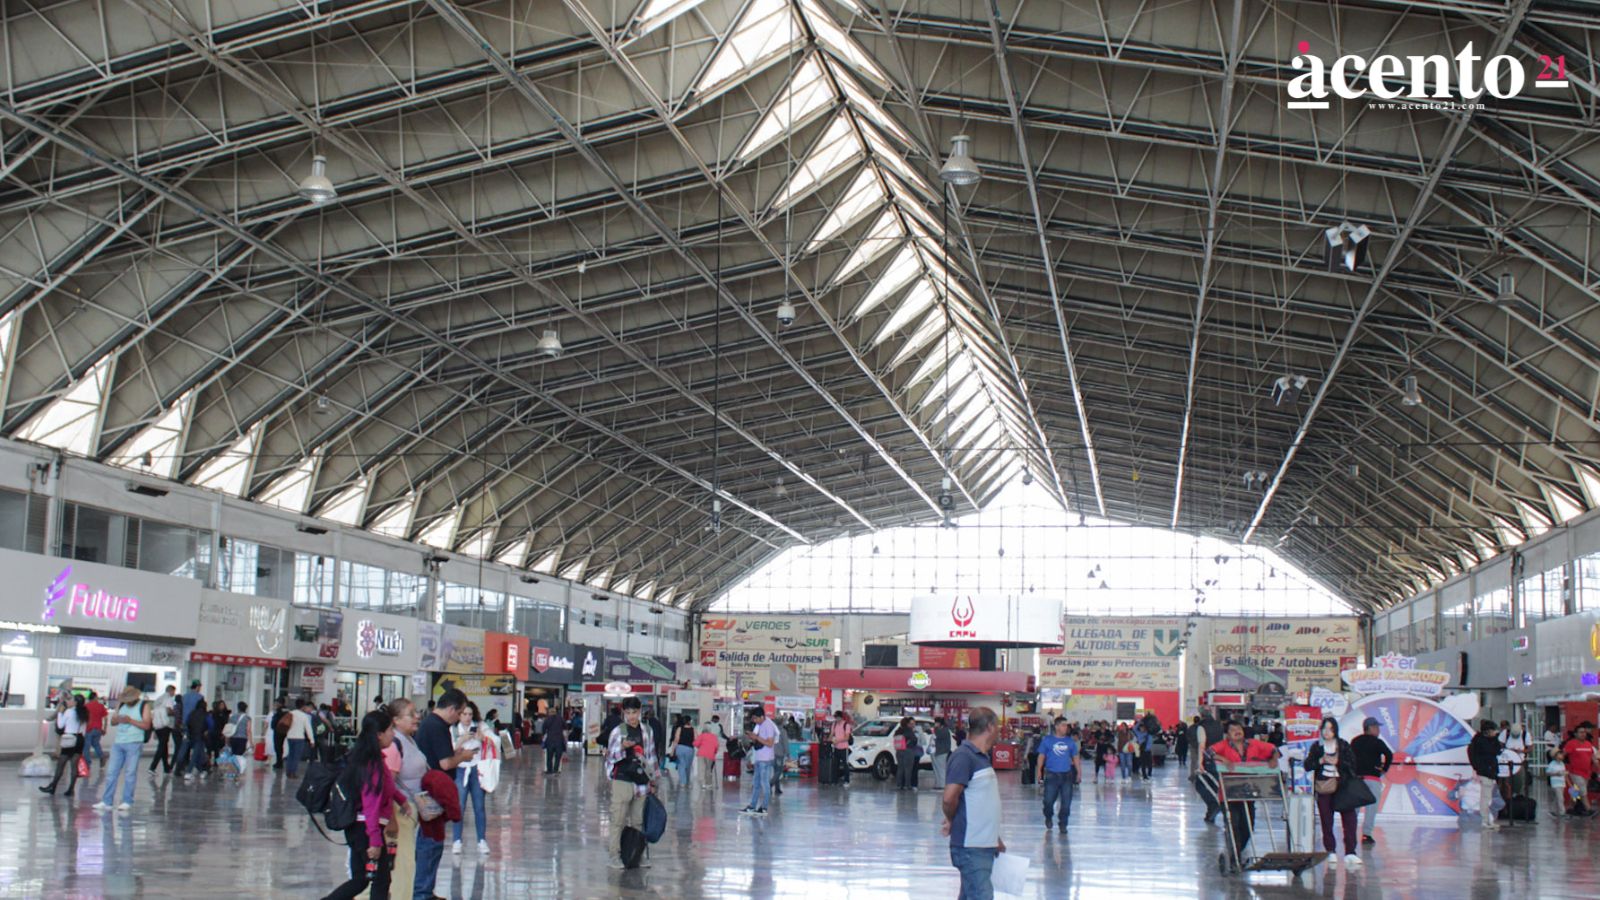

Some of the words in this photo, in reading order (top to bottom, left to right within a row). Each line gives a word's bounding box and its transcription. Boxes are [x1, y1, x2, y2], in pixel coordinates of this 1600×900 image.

[68, 582, 140, 622] Futura
[746, 620, 791, 630] VERDES
[1230, 625, 1259, 634] ADO
[1265, 622, 1290, 631] ADO
[1070, 629, 1122, 639] LLEGADA
[1132, 629, 1148, 639] DE
[1296, 626, 1320, 635] ADO
[805, 638, 829, 647] SUR
[1073, 641, 1140, 651] AUTOBUSES
[719, 650, 750, 662] Salida
[755, 651, 766, 662] de
[769, 652, 823, 664] Autobuses
[1223, 656, 1259, 667] Salida
[1260, 656, 1275, 667] de
[1278, 656, 1338, 668] Autobuses
[1046, 657, 1081, 667] Gracias
[1083, 659, 1099, 668] por
[1114, 658, 1170, 668] Preferencia
